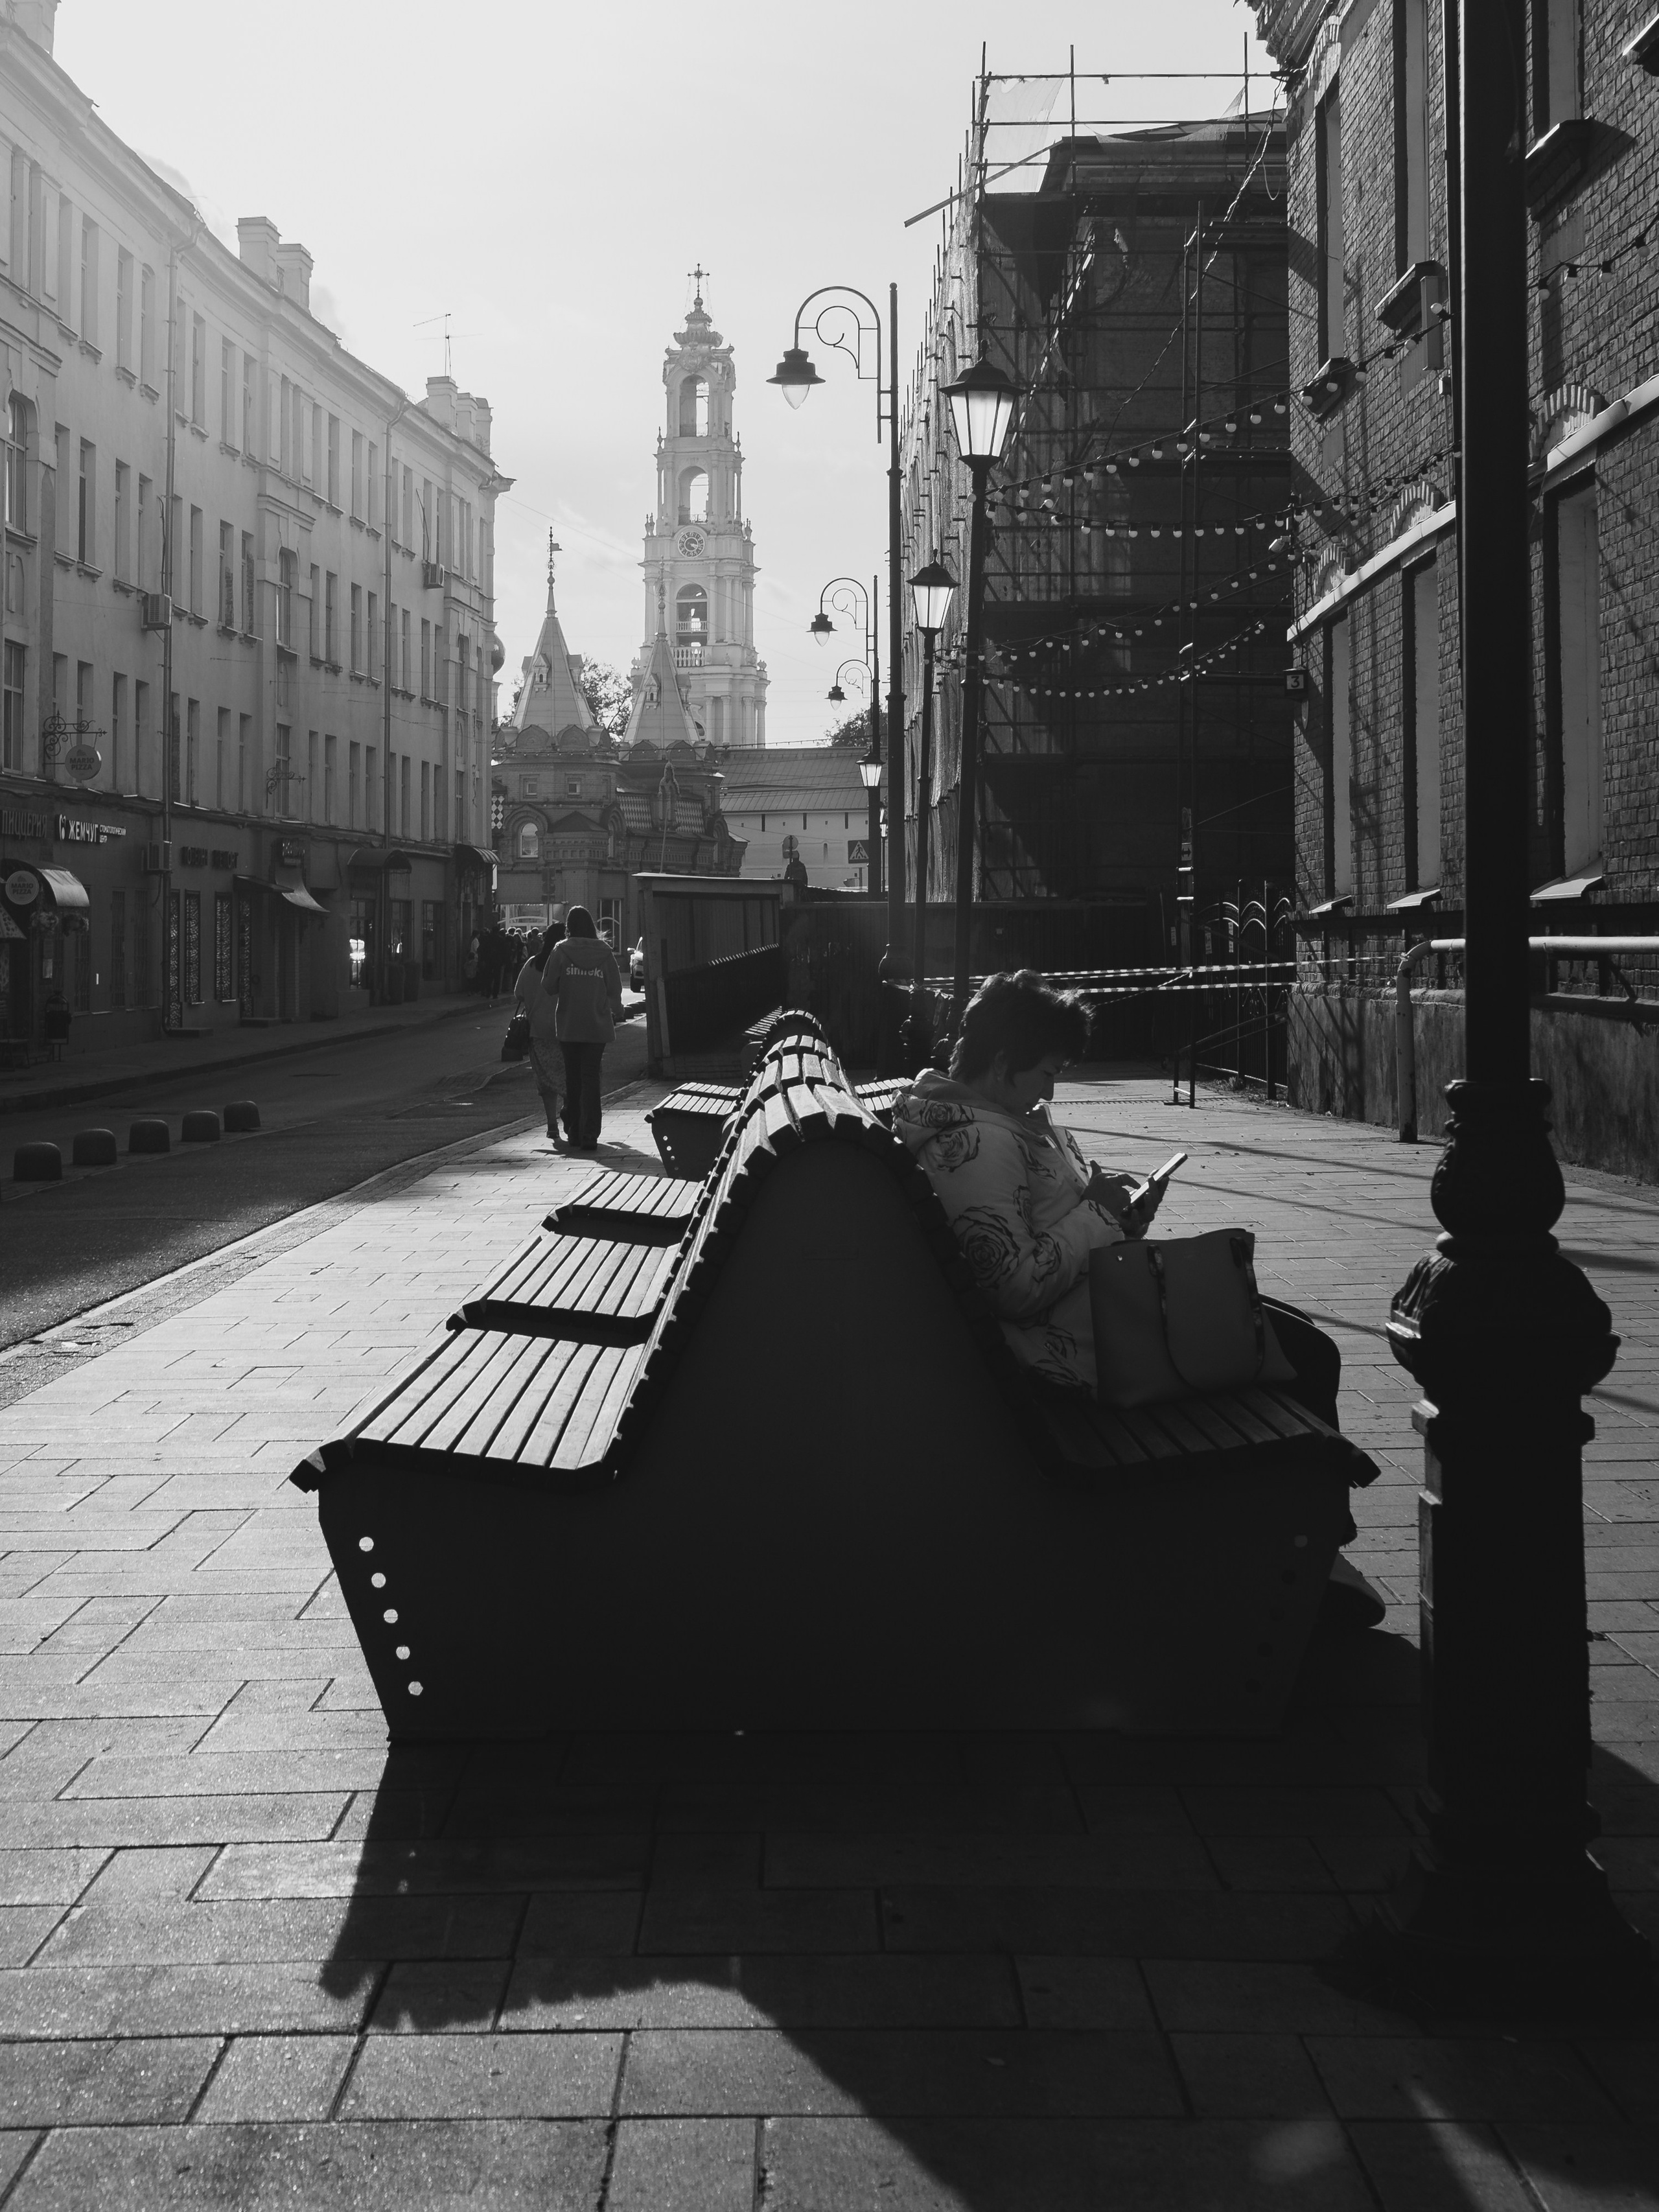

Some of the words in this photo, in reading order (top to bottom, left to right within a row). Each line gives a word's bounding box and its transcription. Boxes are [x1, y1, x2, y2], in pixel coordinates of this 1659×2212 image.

[1291, 675, 1300, 688] 3
[2, 810, 47, 840] ПИЦЦЕРИЯ
[68, 820, 99, 843] ЖЕМЧУГ
